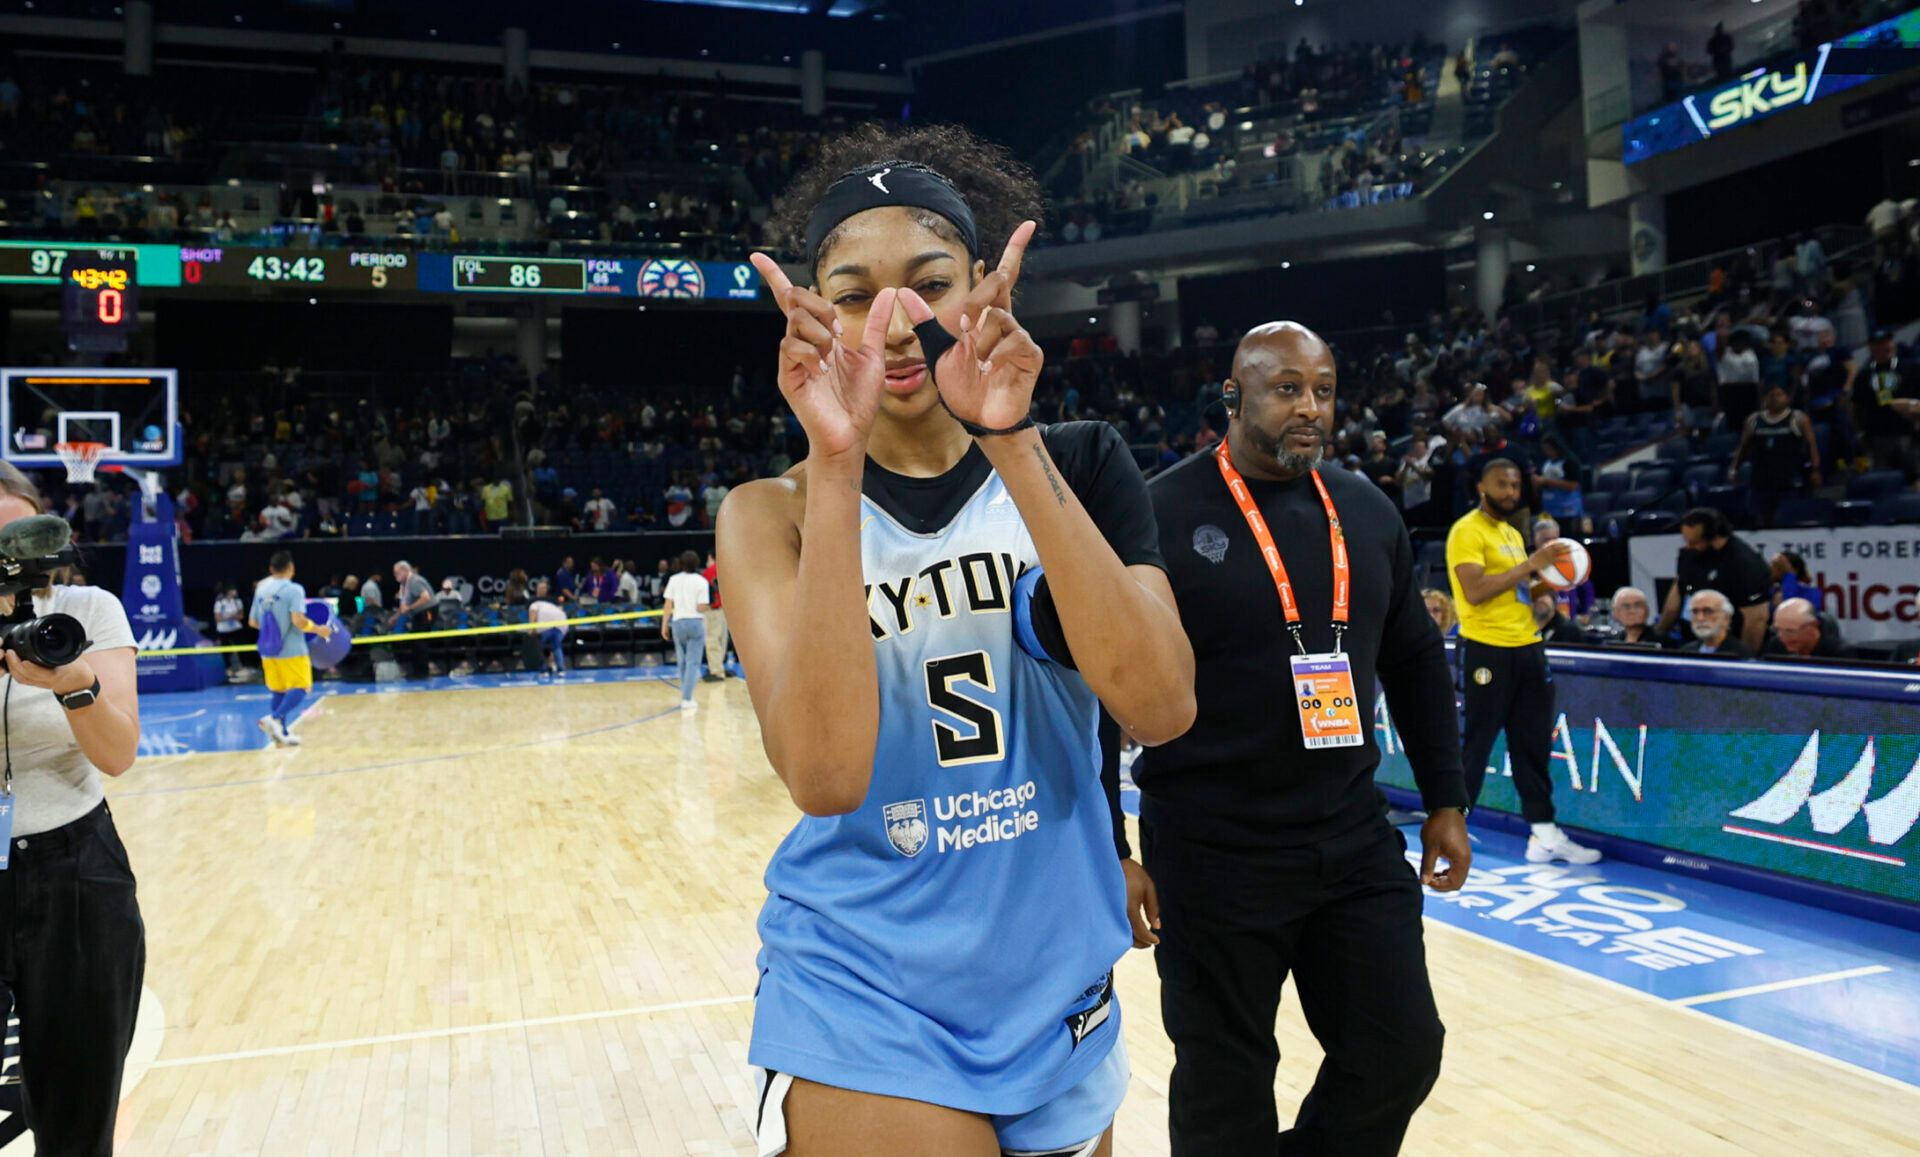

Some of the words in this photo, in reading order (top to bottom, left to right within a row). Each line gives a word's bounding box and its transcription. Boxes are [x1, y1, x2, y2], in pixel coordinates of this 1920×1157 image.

[1707, 62, 1807, 129] SKY
[31, 249, 68, 275] 97
[180, 248, 223, 262] SHOT
[350, 252, 407, 267] PERIOD
[587, 260, 623, 273] FOUL
[184, 261, 203, 284] 0
[248, 256, 325, 281] 43:42
[371, 266, 388, 288] 5
[509, 264, 541, 287] 86
[98, 289, 122, 323] 0
[1815, 571, 1920, 622] hica
[924, 650, 1005, 768] 5
[1318, 719, 1352, 727] WNBA
[934, 780, 1036, 821] UChicago
[936, 810, 1039, 853] Medicine
